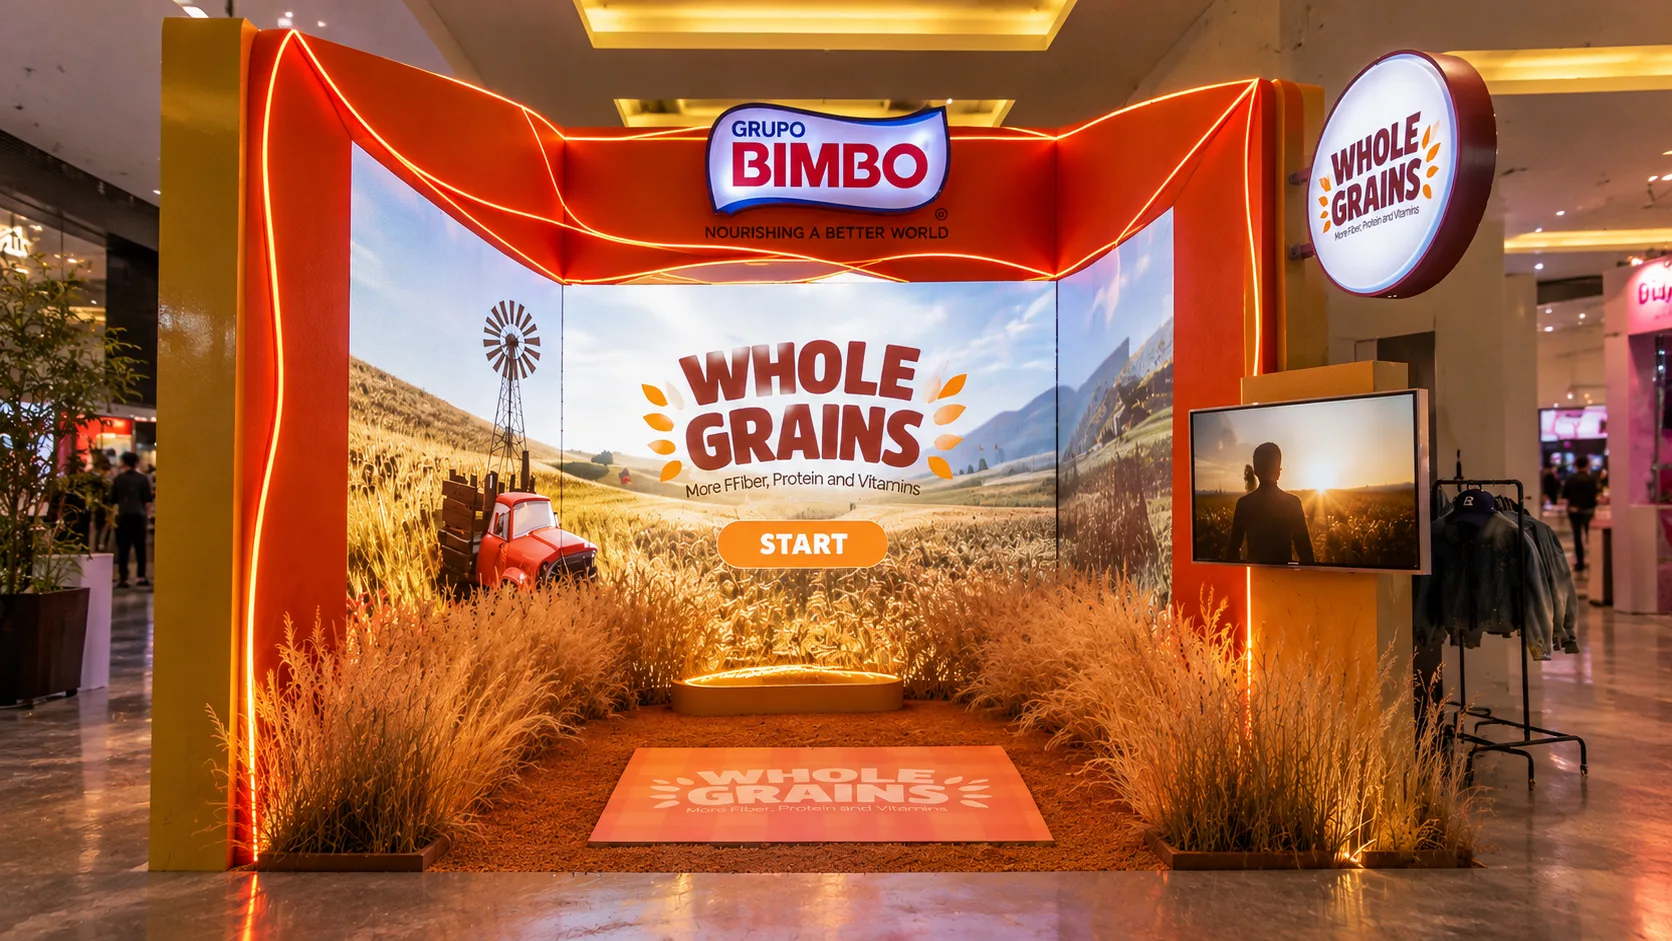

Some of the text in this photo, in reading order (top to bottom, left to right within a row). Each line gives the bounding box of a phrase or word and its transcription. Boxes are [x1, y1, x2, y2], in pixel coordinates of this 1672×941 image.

[731, 120, 806, 138] GRUPO
[1331, 111, 1421, 186] WHOLE
[732, 141, 928, 189] BIMBO
[1331, 157, 1422, 227] GRAINS
[705, 226, 949, 239] NOURISHING A BETTER WORLD
[678, 339, 921, 406] WHOLE
[685, 403, 924, 471] GRAINS
[686, 470, 921, 498] More FFiber, Protein and Vitamins
[760, 533, 848, 555] START
[696, 768, 936, 784] WHOLE
[687, 784, 949, 805] GRAINS
[778, 804, 836, 812] Protein
[876, 804, 948, 812] Vitamins
